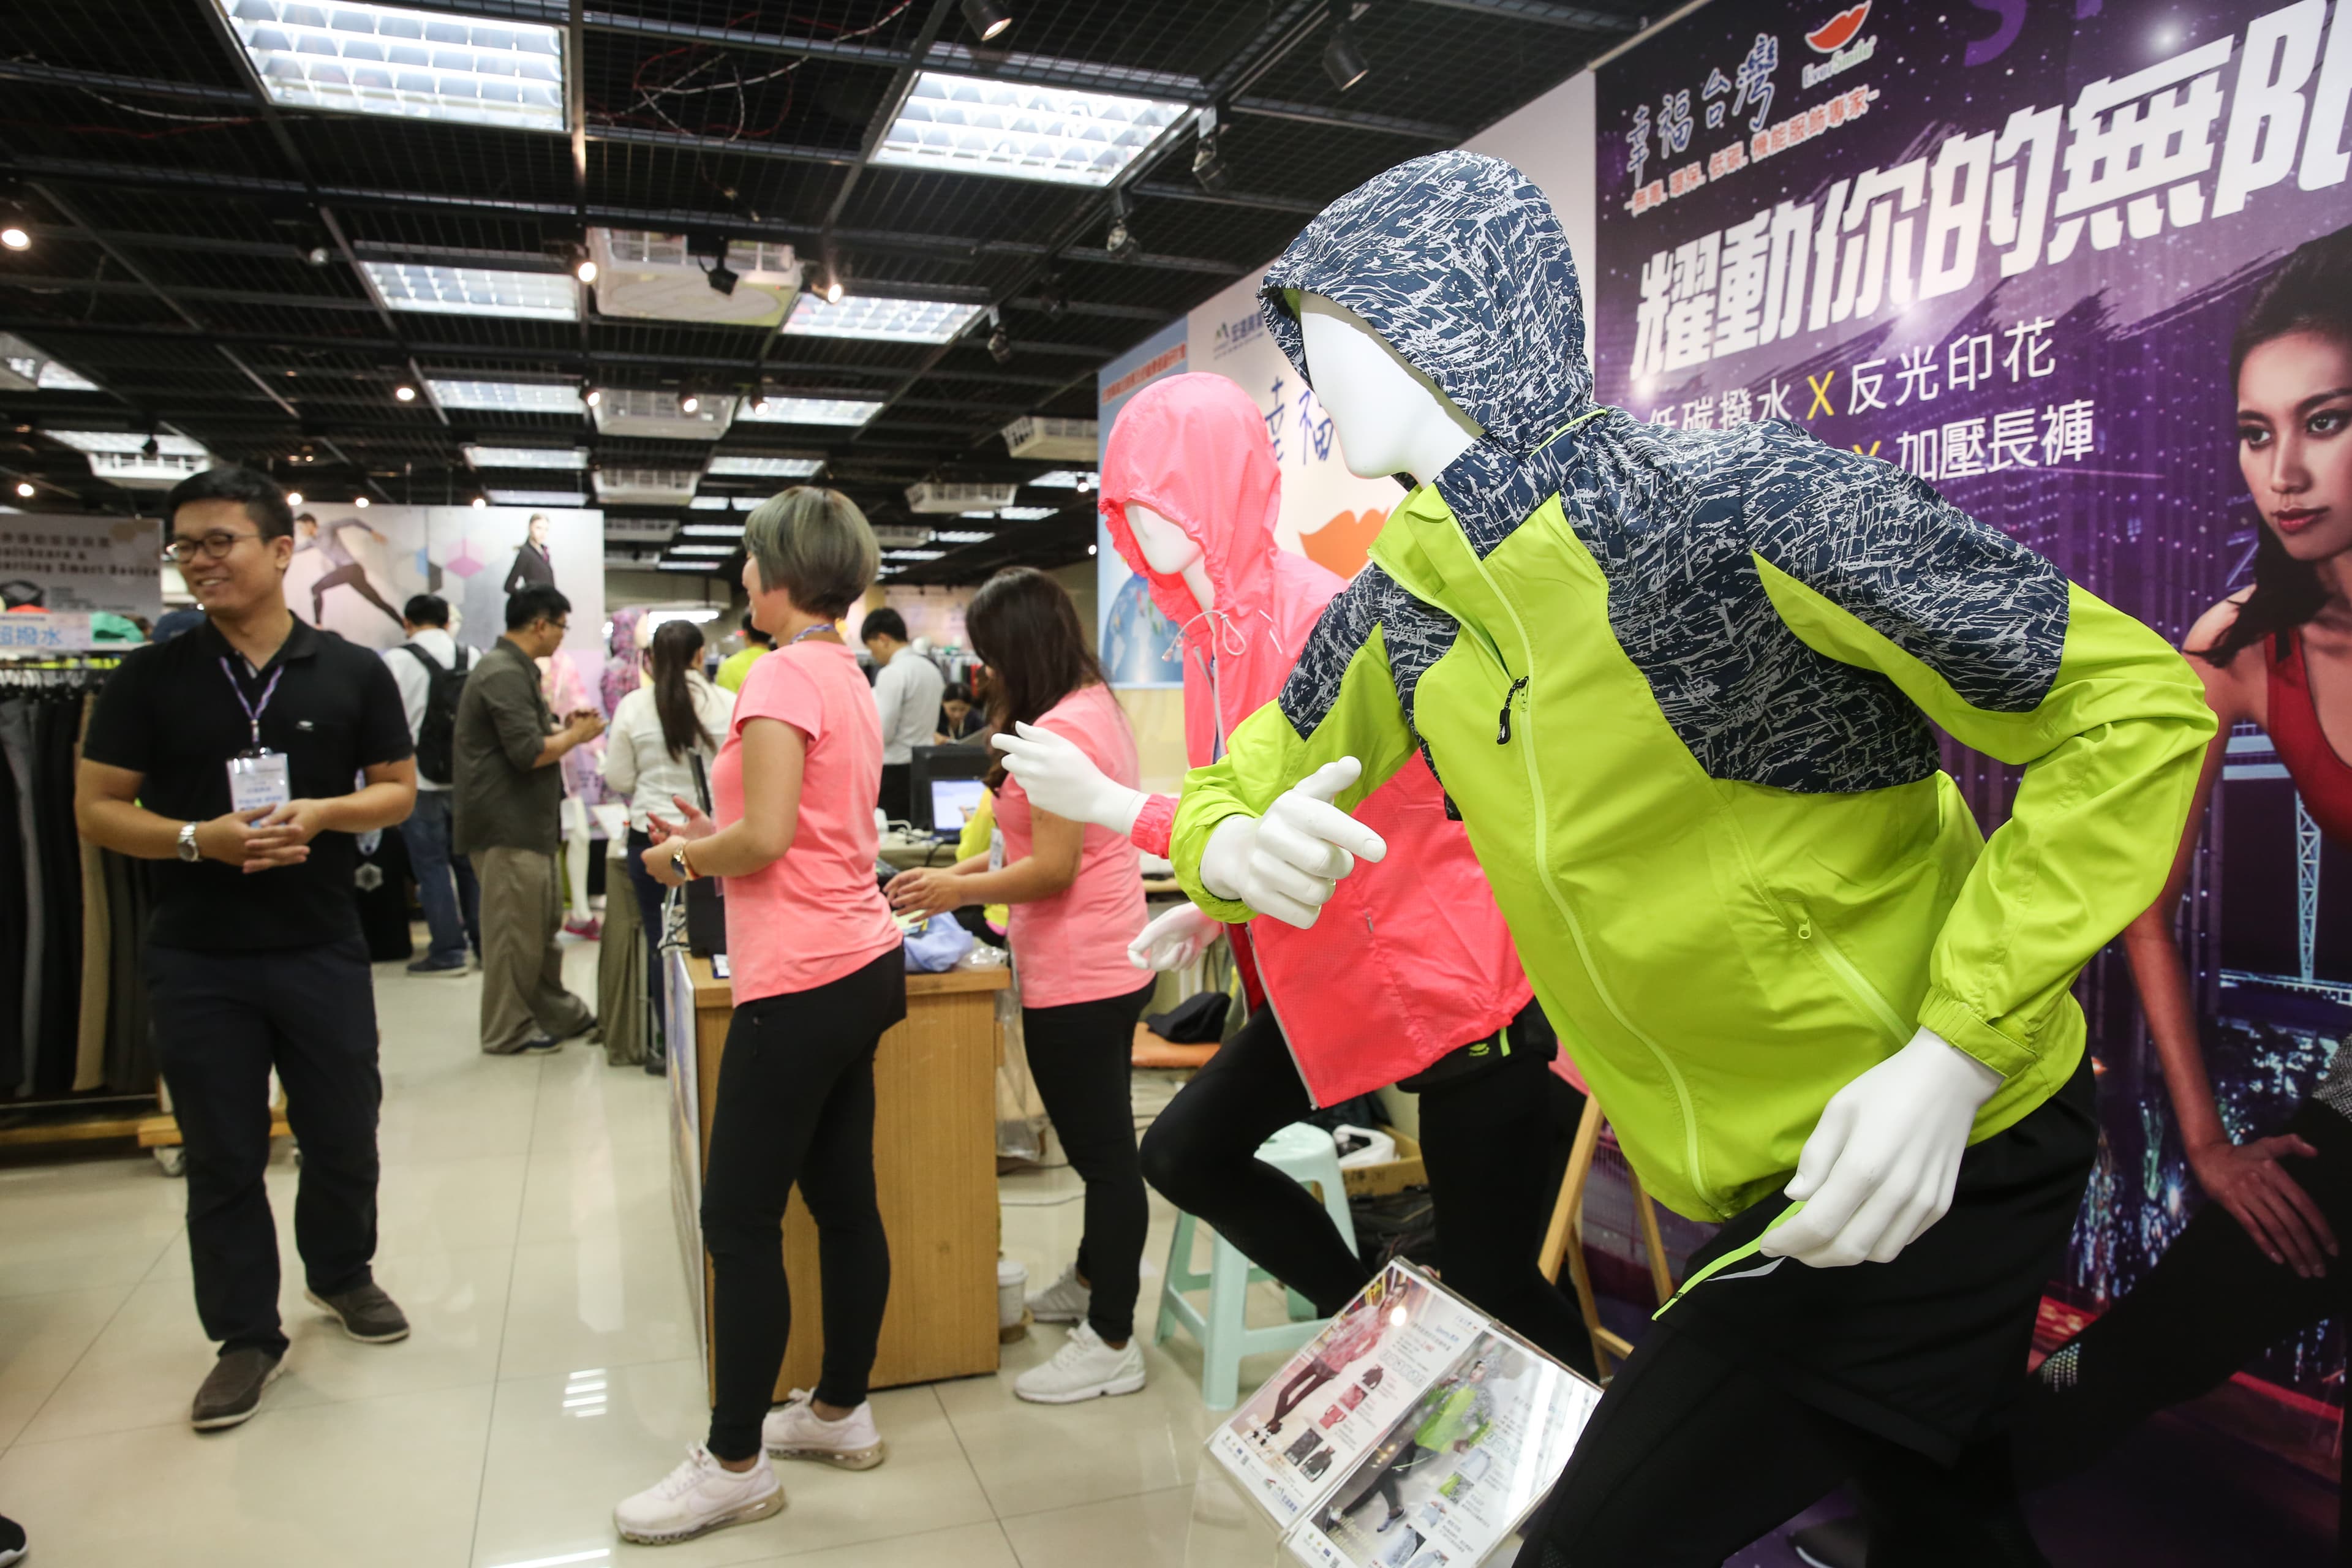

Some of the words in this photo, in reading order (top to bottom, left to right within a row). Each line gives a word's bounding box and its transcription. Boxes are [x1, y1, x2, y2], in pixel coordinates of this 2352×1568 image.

[1627, 34, 1777, 188] 幸福台灣
[1847, 316, 2056, 416] 反光印花
[1896, 399, 2095, 483] 加壓長褲
